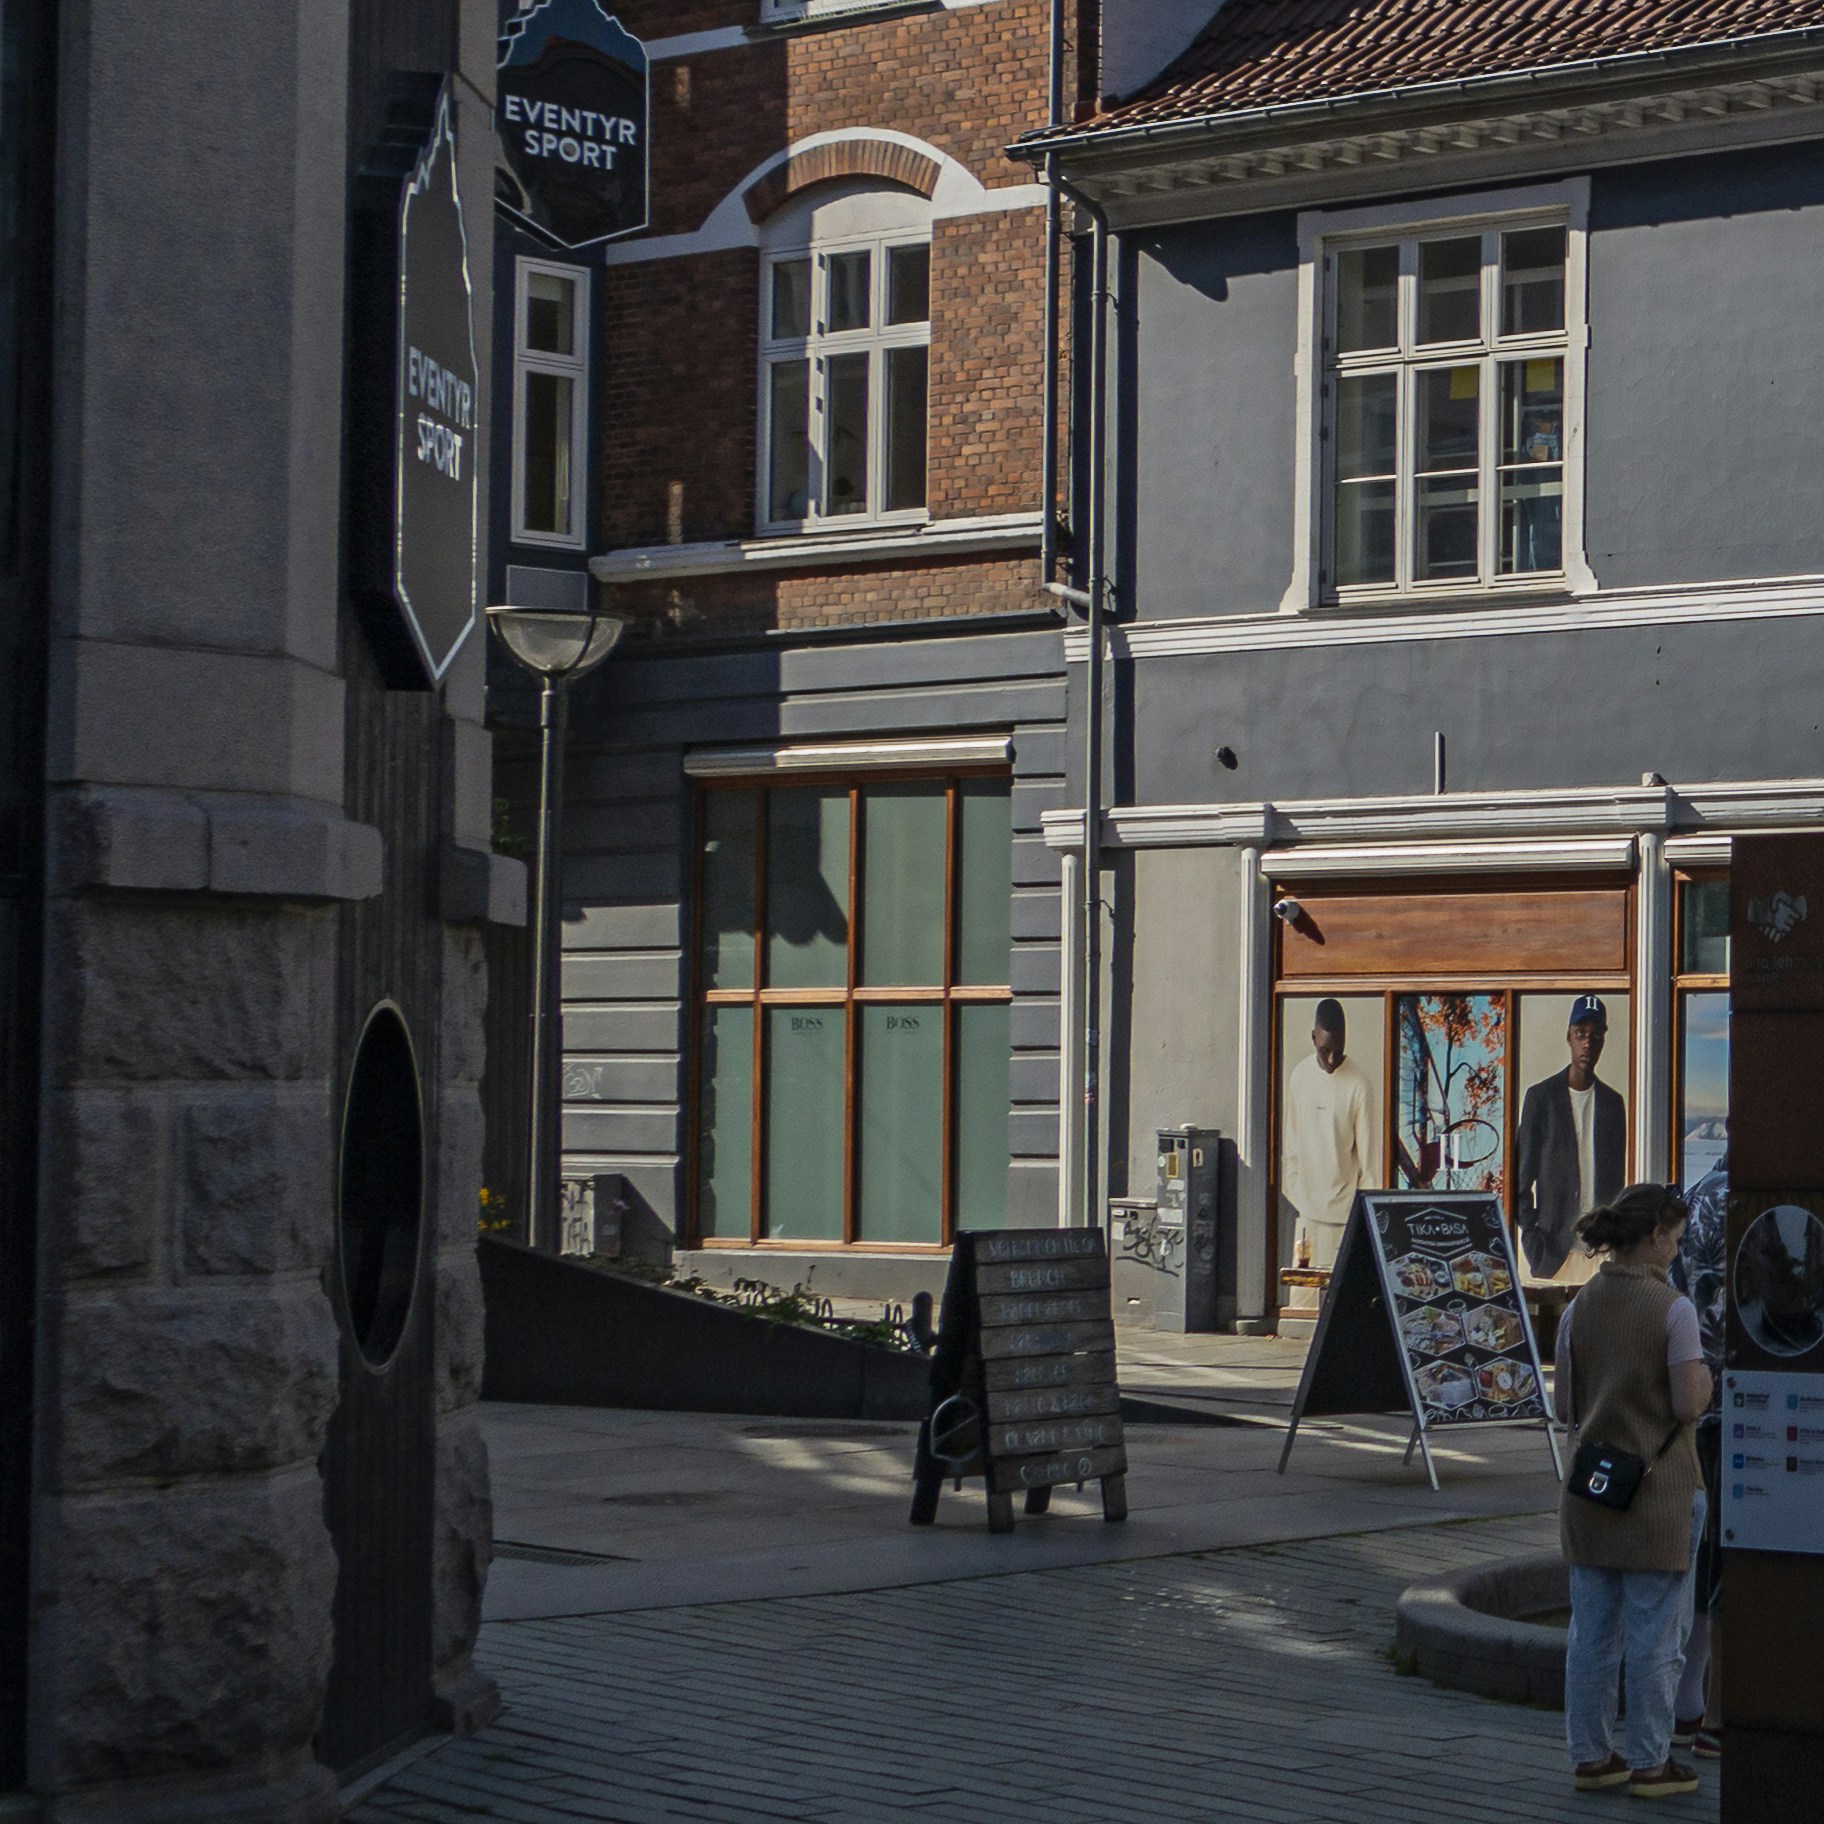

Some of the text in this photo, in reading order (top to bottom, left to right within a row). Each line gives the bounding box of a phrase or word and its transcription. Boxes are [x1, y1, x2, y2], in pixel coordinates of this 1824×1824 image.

[505, 94, 636, 145] EVENTYR
[525, 129, 617, 170] SPORT
[409, 346, 471, 429] EVENTYR
[417, 412, 462, 481] SPORT
[791, 1017, 824, 1031] BOSS
[886, 1015, 920, 1030] BOSS
